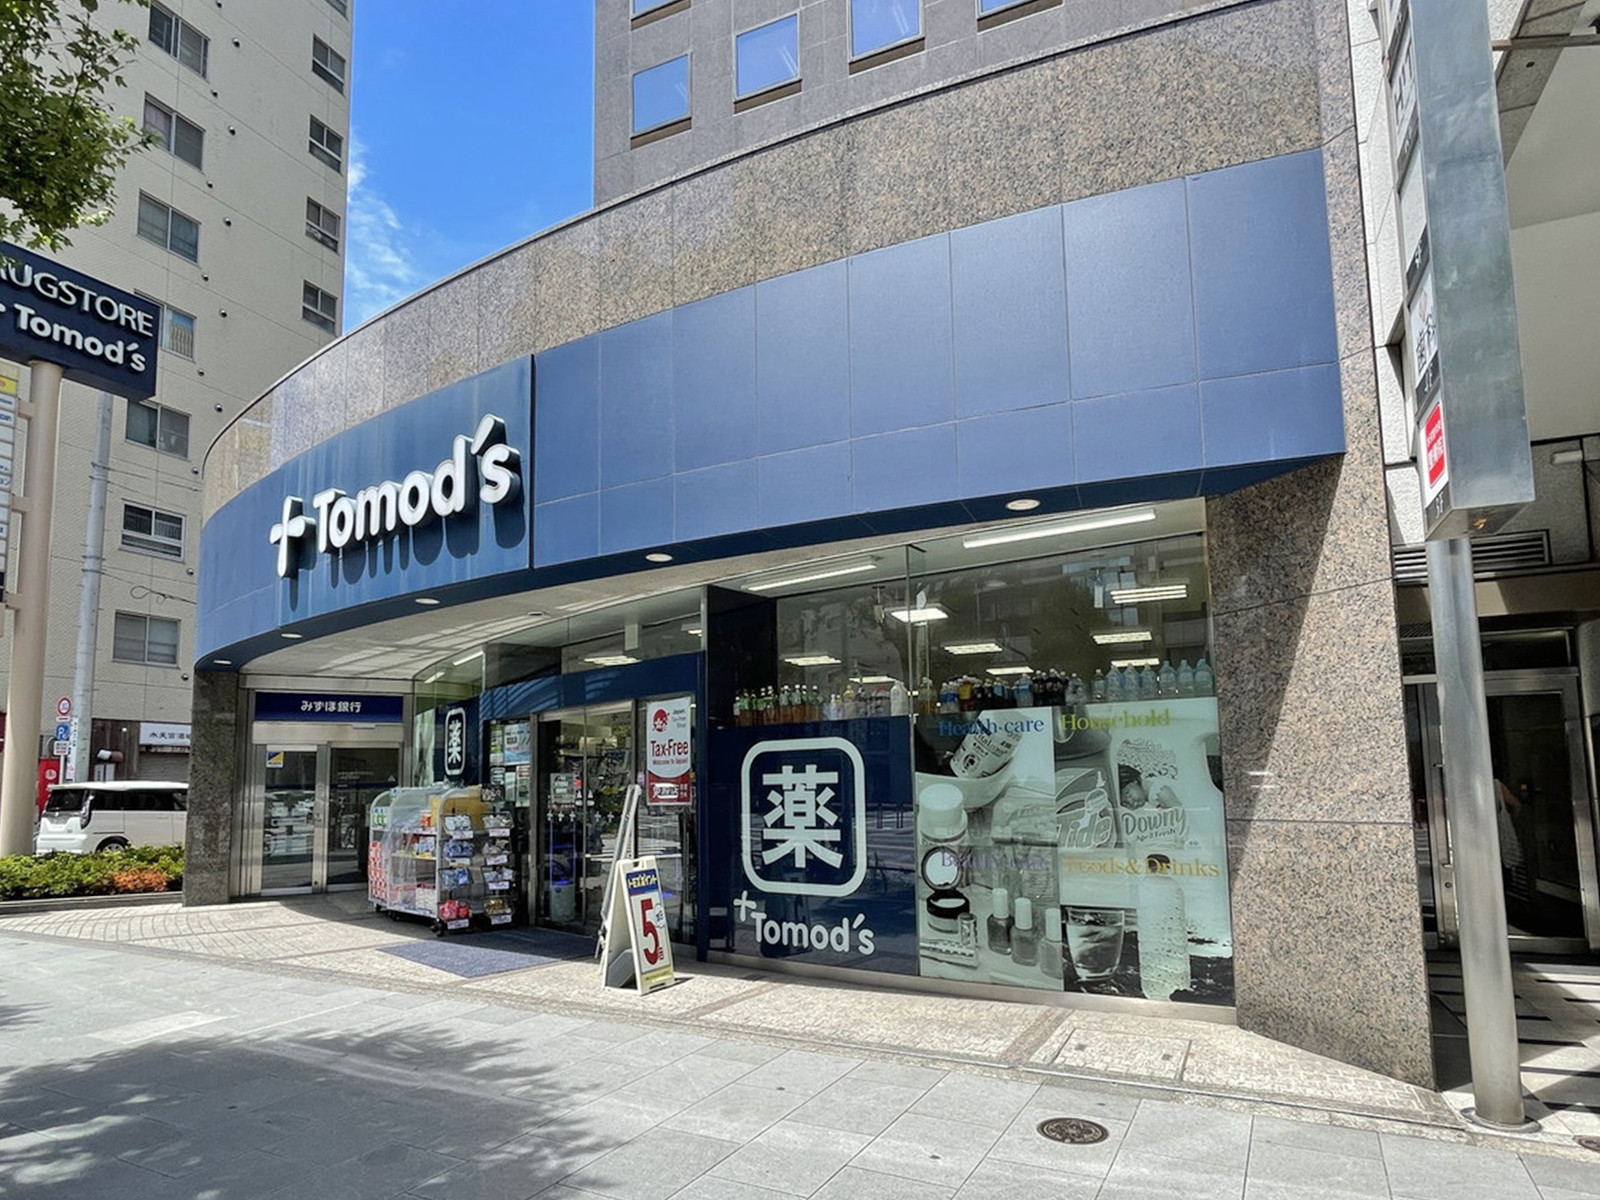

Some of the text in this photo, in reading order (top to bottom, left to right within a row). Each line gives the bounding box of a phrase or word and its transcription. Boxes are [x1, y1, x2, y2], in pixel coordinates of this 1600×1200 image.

[14, 303, 146, 372] Tomod's
[313, 414, 519, 554] Tomod's
[300, 700, 362, 713] みずほ銀行
[448, 719, 462, 765] 薬
[650, 738, 689, 757] Tax-Free
[761, 763, 844, 869] 薬
[1121, 806, 1187, 837] Downy
[641, 898, 660, 966] 5
[751, 912, 876, 956] Tomod's
